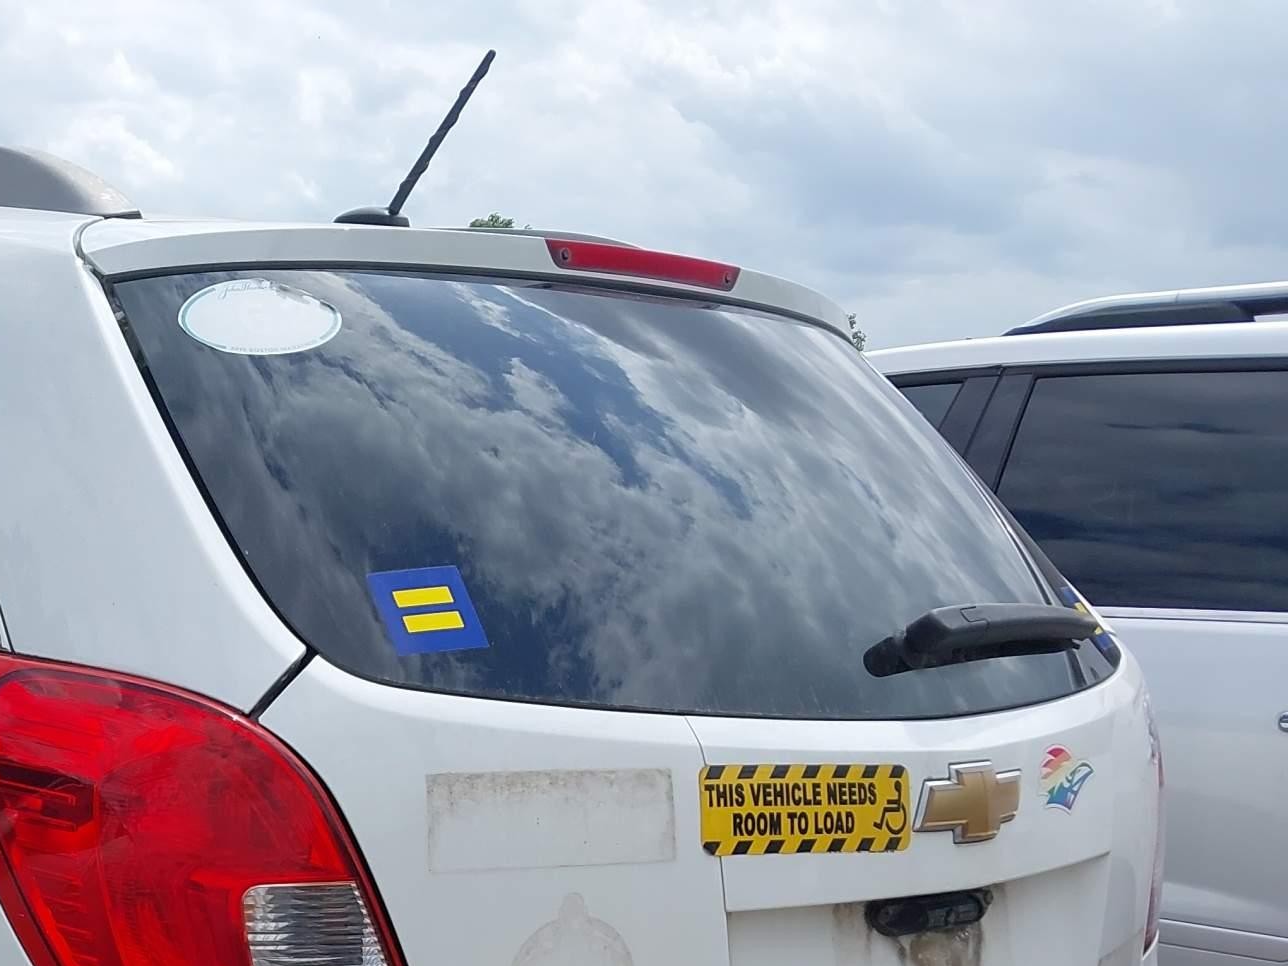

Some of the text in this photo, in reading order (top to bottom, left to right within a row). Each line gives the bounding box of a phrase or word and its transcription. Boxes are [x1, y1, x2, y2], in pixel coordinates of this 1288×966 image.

[704, 783, 877, 808] THIS VEHICLE NEEDS
[732, 811, 855, 837] ROOM TO LOAD
